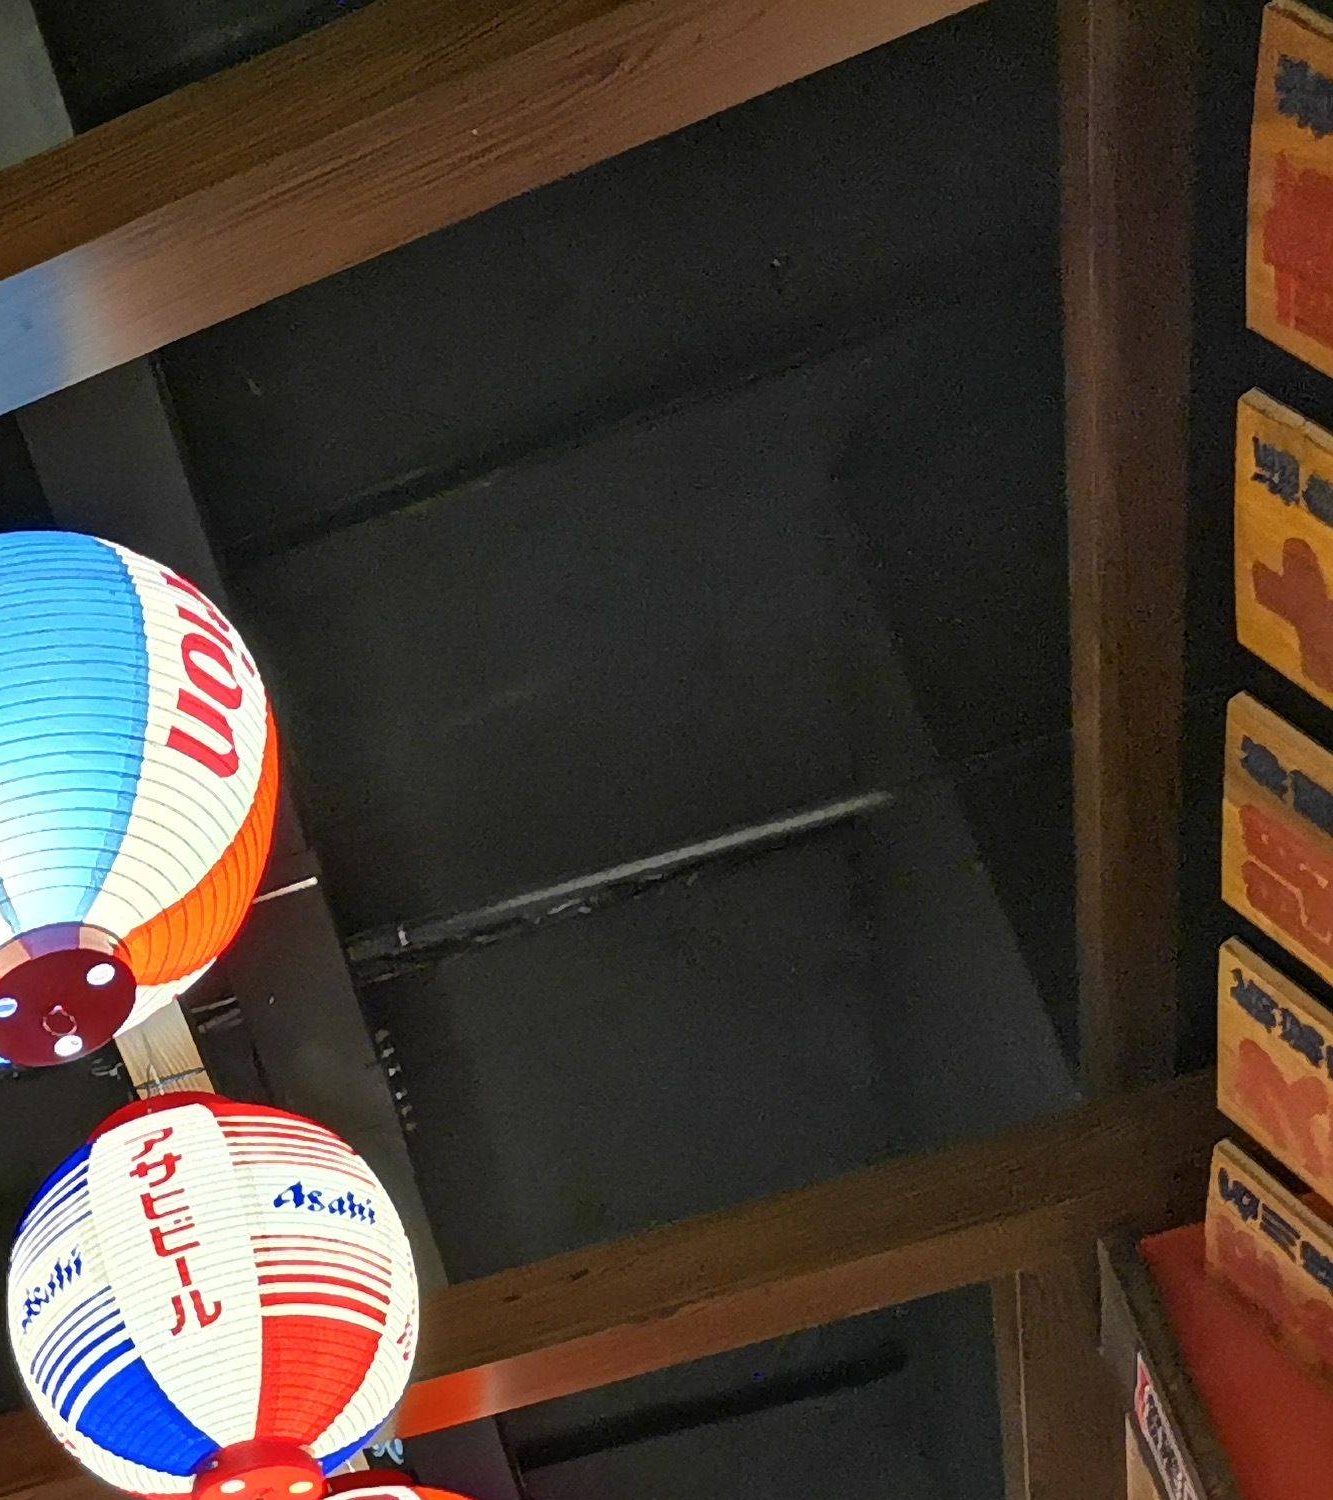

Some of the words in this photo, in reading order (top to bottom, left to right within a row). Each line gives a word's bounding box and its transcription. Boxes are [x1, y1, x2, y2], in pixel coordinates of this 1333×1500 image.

[124, 1126, 222, 1336] アサヒビール
[273, 1180, 377, 1226] Asahi
